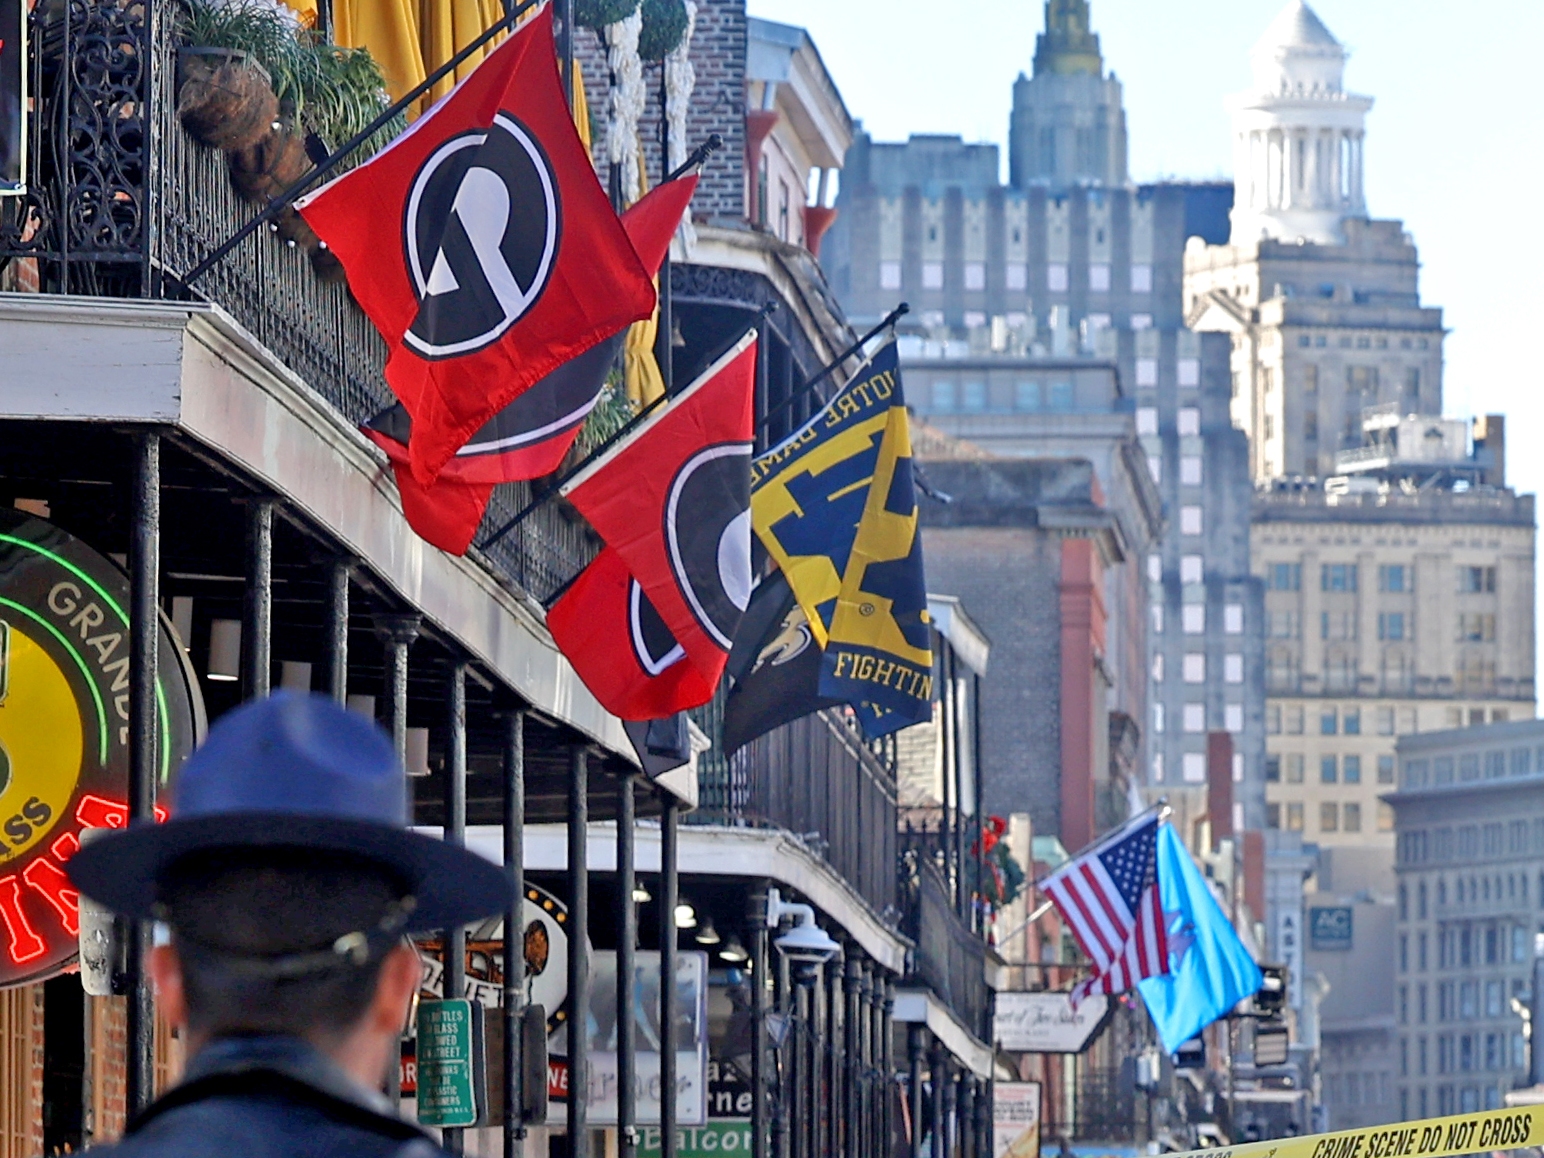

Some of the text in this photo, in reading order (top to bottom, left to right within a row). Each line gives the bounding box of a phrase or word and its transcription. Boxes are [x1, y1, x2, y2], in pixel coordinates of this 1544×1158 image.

[1419, 1126, 1443, 1153] DO
[1443, 1120, 1480, 1150] NOT
[1478, 1114, 1533, 1145] CROSS
